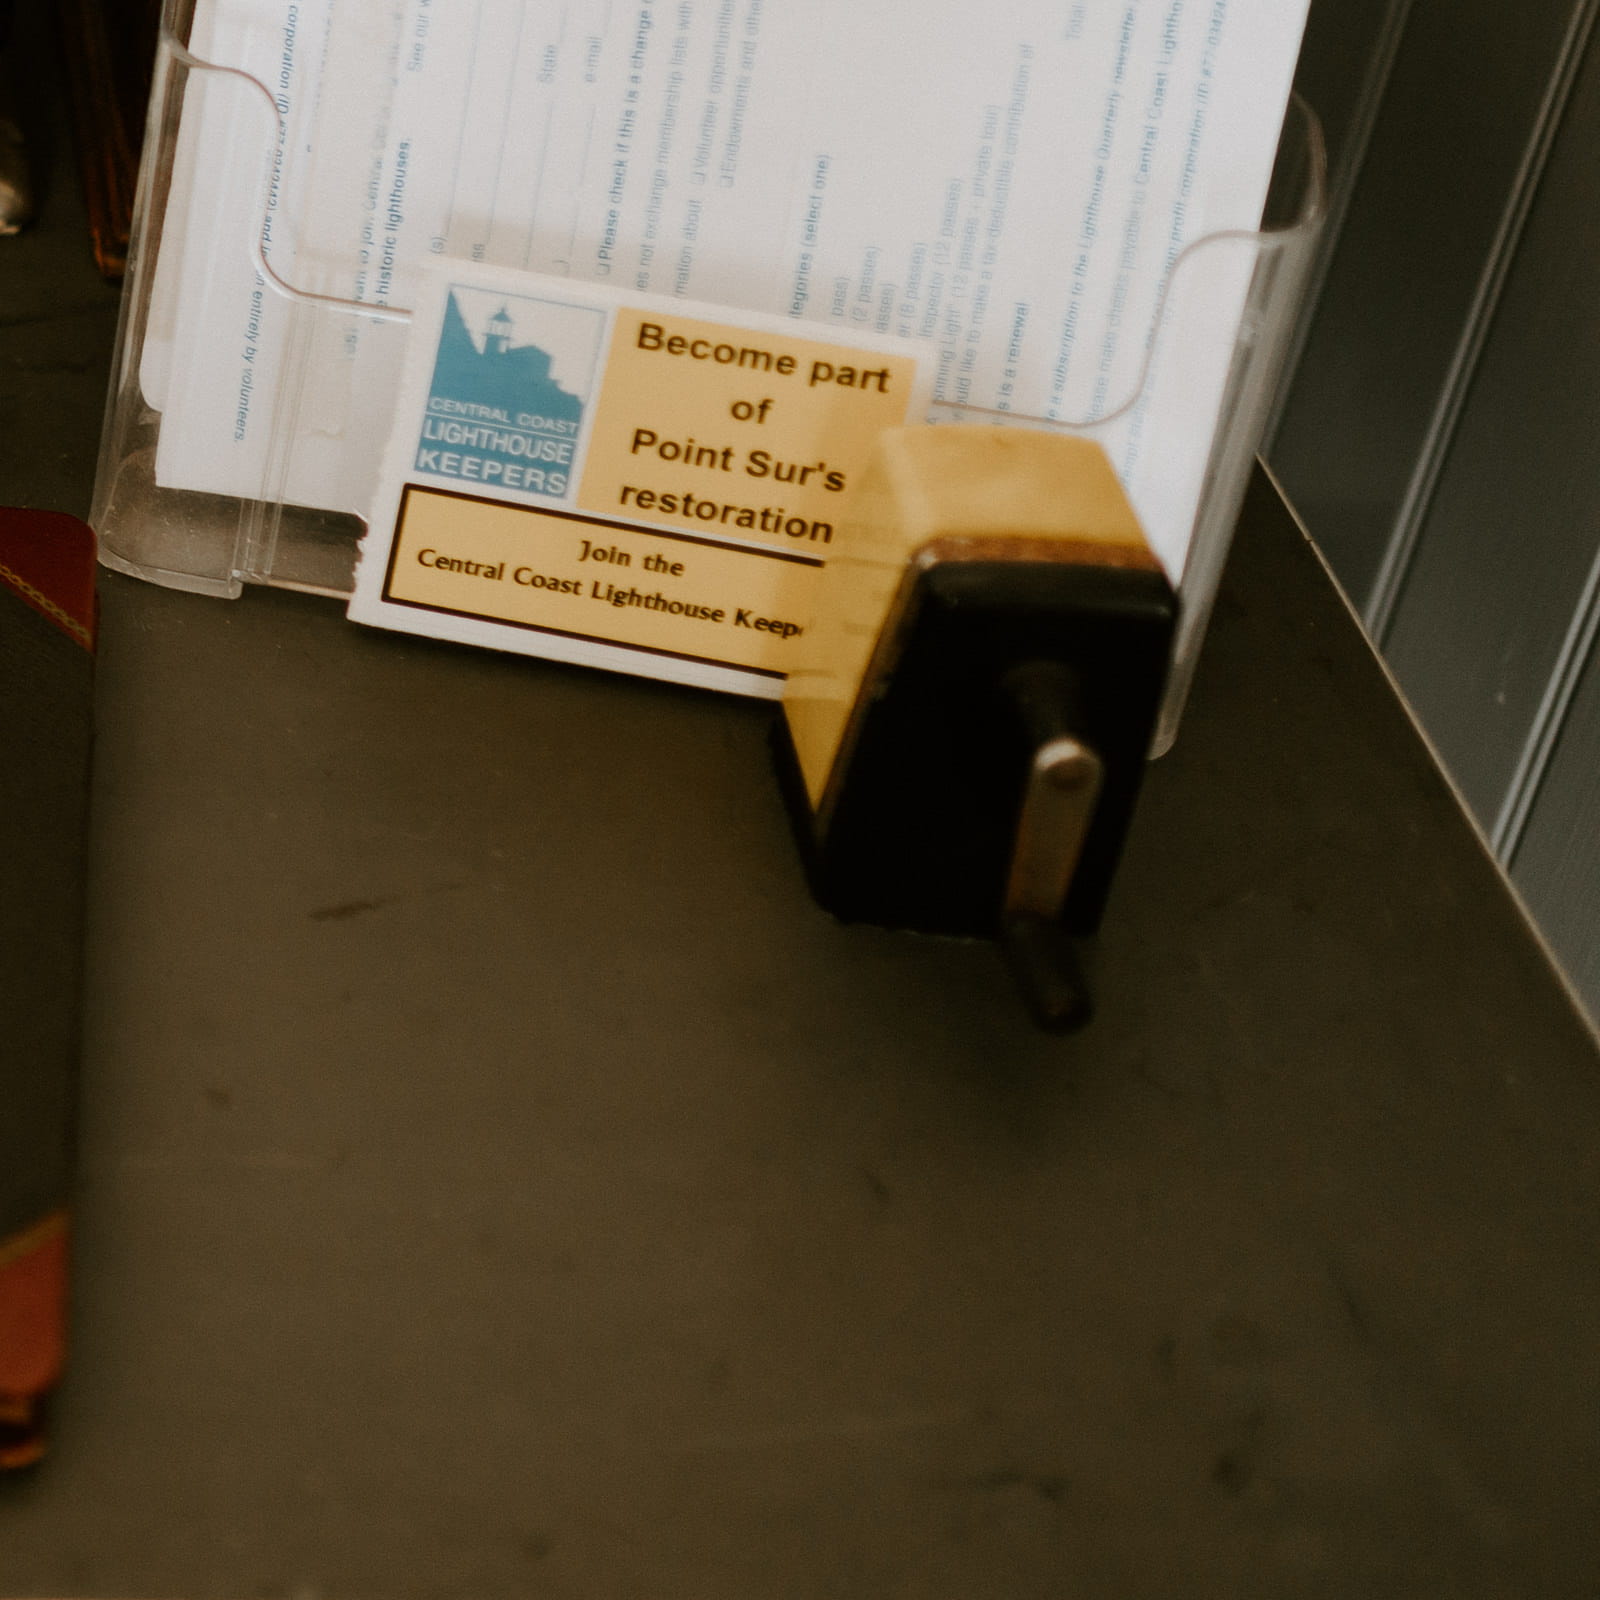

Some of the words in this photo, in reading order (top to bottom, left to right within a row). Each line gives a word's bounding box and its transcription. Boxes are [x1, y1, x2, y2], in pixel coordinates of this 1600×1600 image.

[413, 13, 431, 38] our
[628, 7, 656, 70] change
[675, 0, 695, 32] with
[1063, 2, 1088, 42] Total
[274, 4, 301, 90] corporation
[406, 41, 427, 72] See
[535, 43, 559, 84] State
[579, 36, 603, 84] e-mail
[669, 34, 689, 66] lists
[272, 93, 290, 114] (ID
[623, 88, 640, 103] is
[654, 70, 686, 165] membership
[722, 75, 752, 172] Endowments
[737, 40, 758, 71] and
[615, 108, 637, 139] this
[691, 99, 719, 168] Volunteer
[1094, 89, 1125, 161] Quarterly
[1131, 124, 1157, 186] Central
[1144, 70, 1168, 120] Coast
[606, 157, 630, 204] check
[809, 152, 833, 190] one)
[643, 168, 670, 239] exchange
[681, 198, 703, 241] about
[798, 193, 825, 248] (select
[1077, 163, 1110, 250] Lighthouse
[596, 208, 622, 261] Please
[637, 243, 655, 267] not
[916, 270, 945, 338] Inspector
[937, 176, 964, 238] passes)
[374, 234, 398, 295] historic
[672, 245, 695, 297] mation
[856, 244, 883, 304] passes)
[902, 240, 928, 300] passes)
[1072, 252, 1091, 278] the
[828, 275, 851, 316] pass)
[969, 283, 992, 325] make
[1069, 281, 1086, 296] to
[243, 289, 265, 341] entirely
[965, 327, 981, 343] to
[1003, 300, 1031, 363] renewal
[239, 345, 258, 364] by
[636, 321, 798, 377] Become
[809, 360, 891, 394] part
[959, 348, 978, 373] like
[1051, 301, 1085, 393] subscription
[231, 368, 255, 444] volunteers.
[428, 397, 510, 425] CENTRAL
[519, 412, 580, 436] COAST
[730, 398, 775, 425] of
[423, 418, 573, 465] LIGHTHOUSE
[630, 428, 734, 472] Point
[746, 450, 847, 493] Sur's
[418, 452, 567, 495] KEEPERS
[619, 483, 834, 544] restoration
[579, 540, 632, 567] Join
[643, 552, 685, 577] the
[417, 548, 505, 582] Central
[513, 566, 582, 597] Coast
[592, 580, 725, 624] Lighthouse
